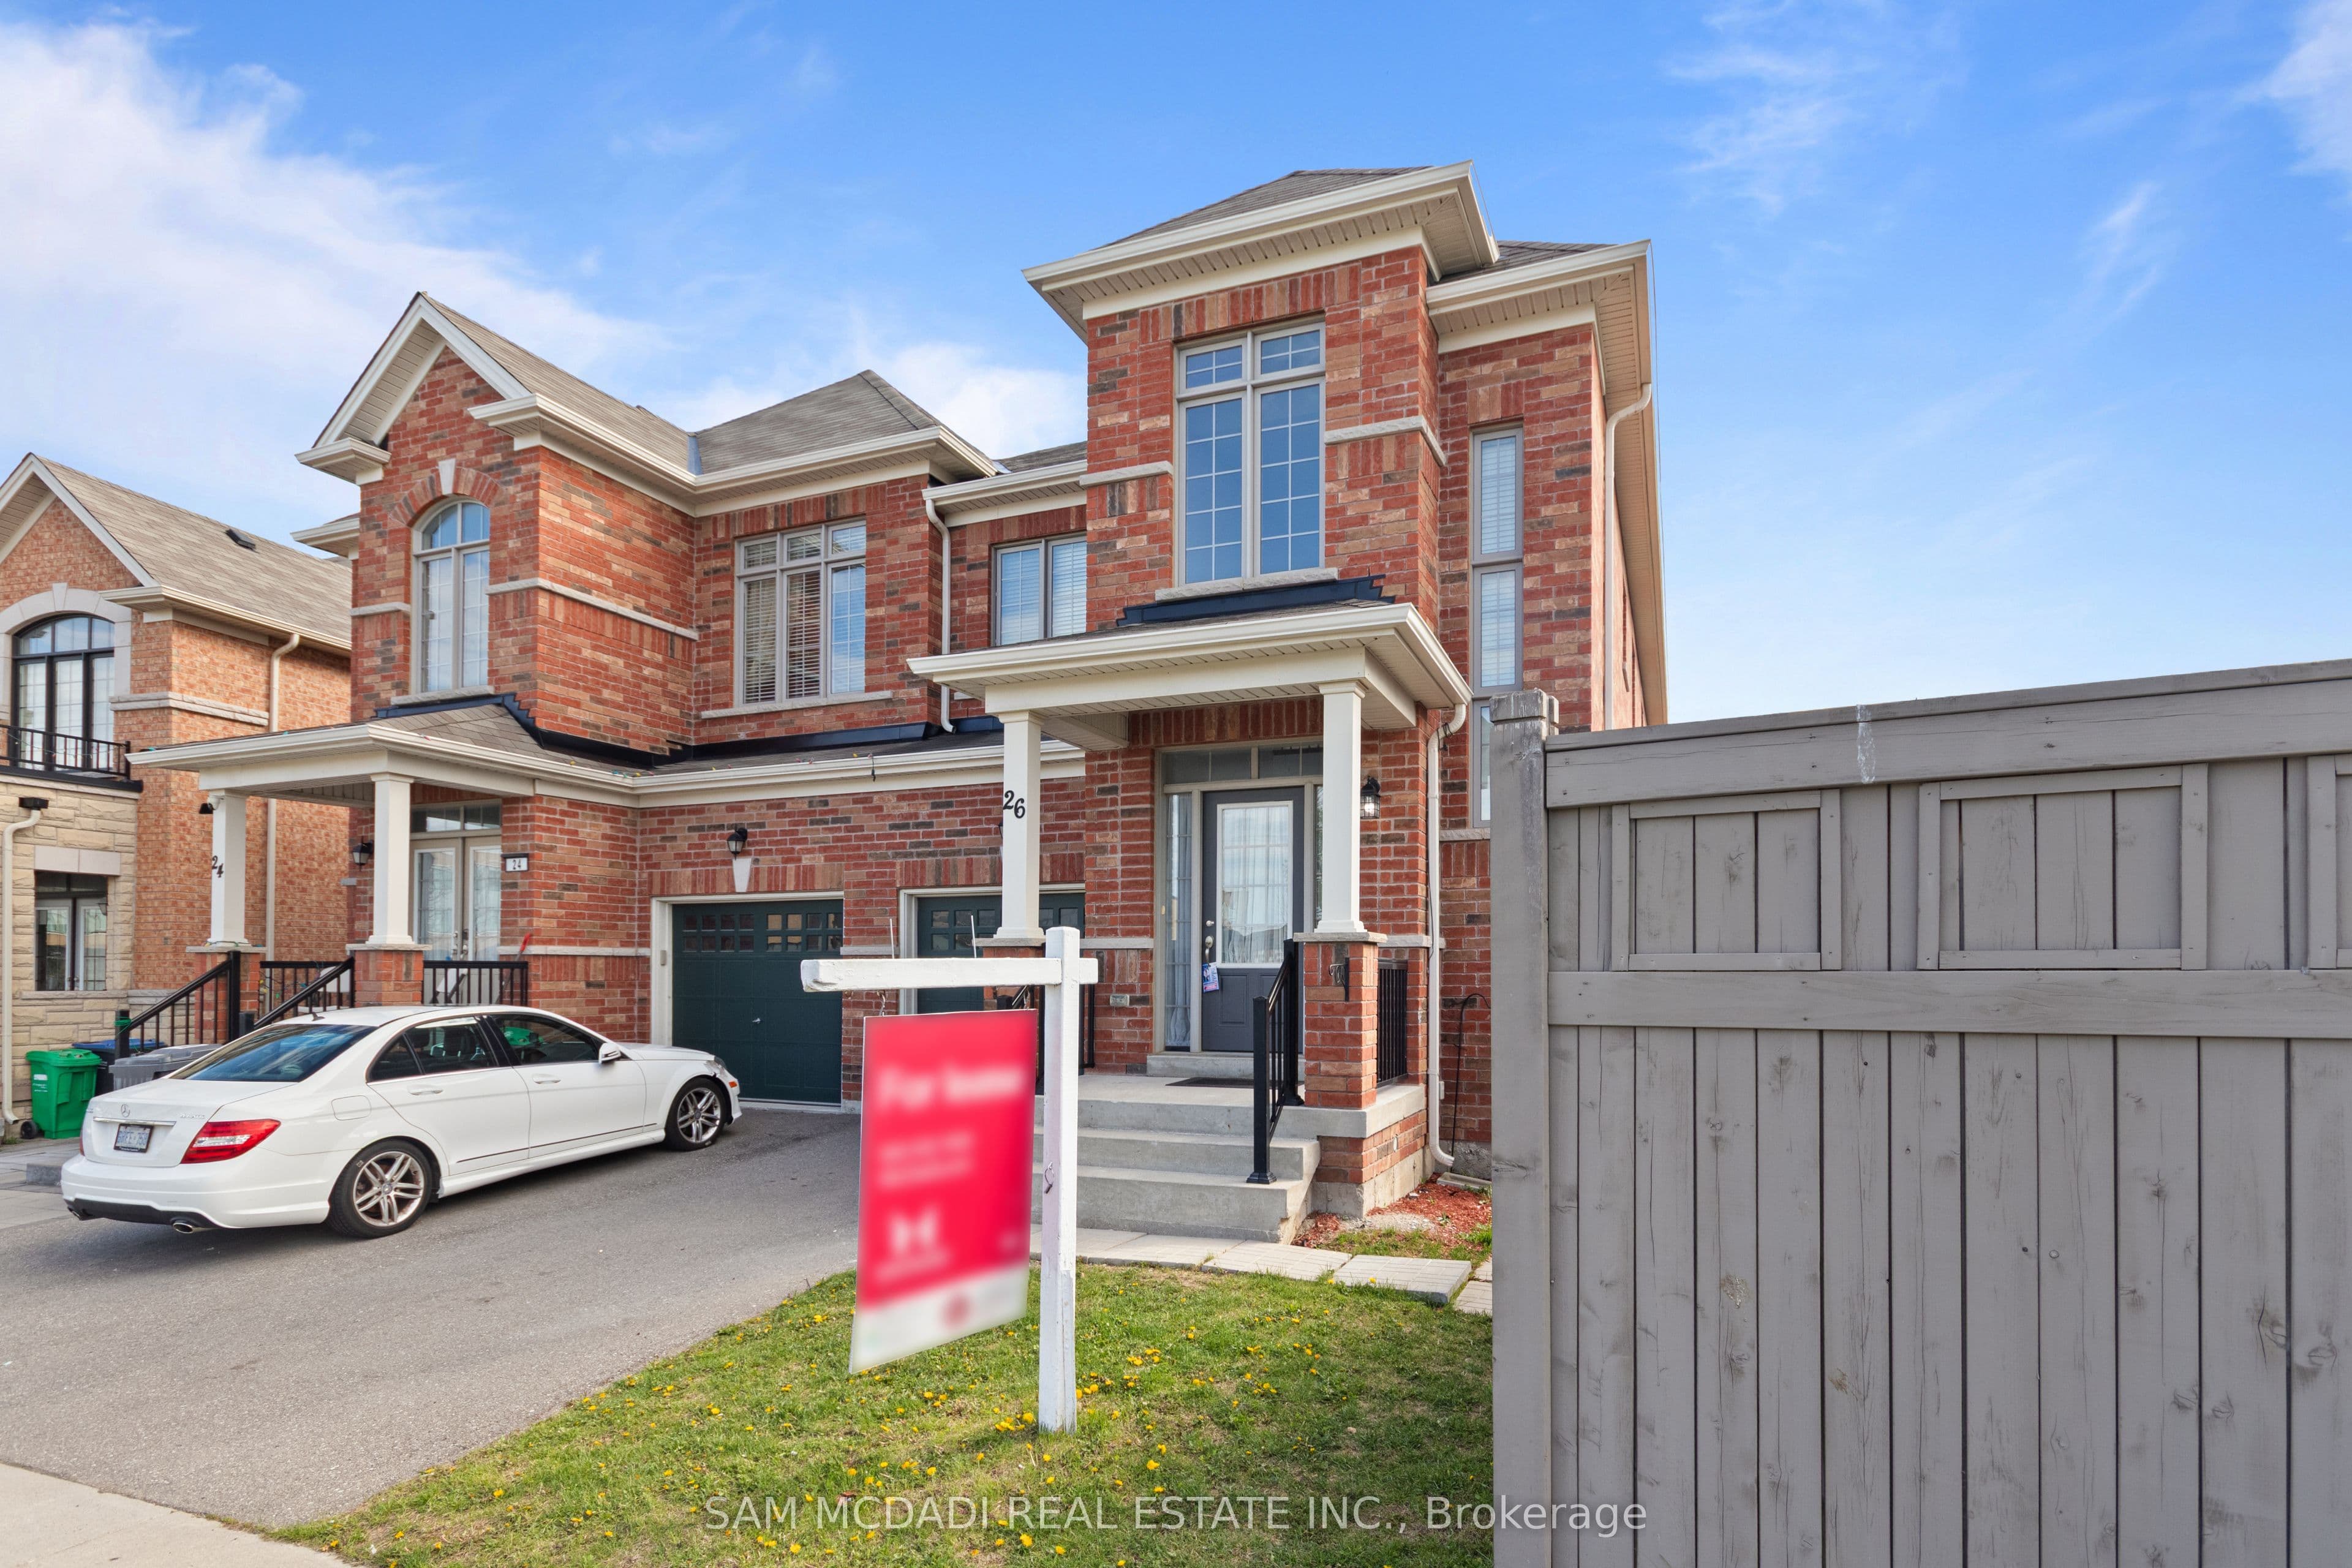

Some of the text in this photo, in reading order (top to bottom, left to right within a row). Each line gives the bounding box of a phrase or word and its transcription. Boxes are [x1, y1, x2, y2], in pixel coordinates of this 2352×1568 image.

[1003, 790, 1025, 819] 26
[212, 855, 224, 878] 24
[513, 859, 521, 870] 24
